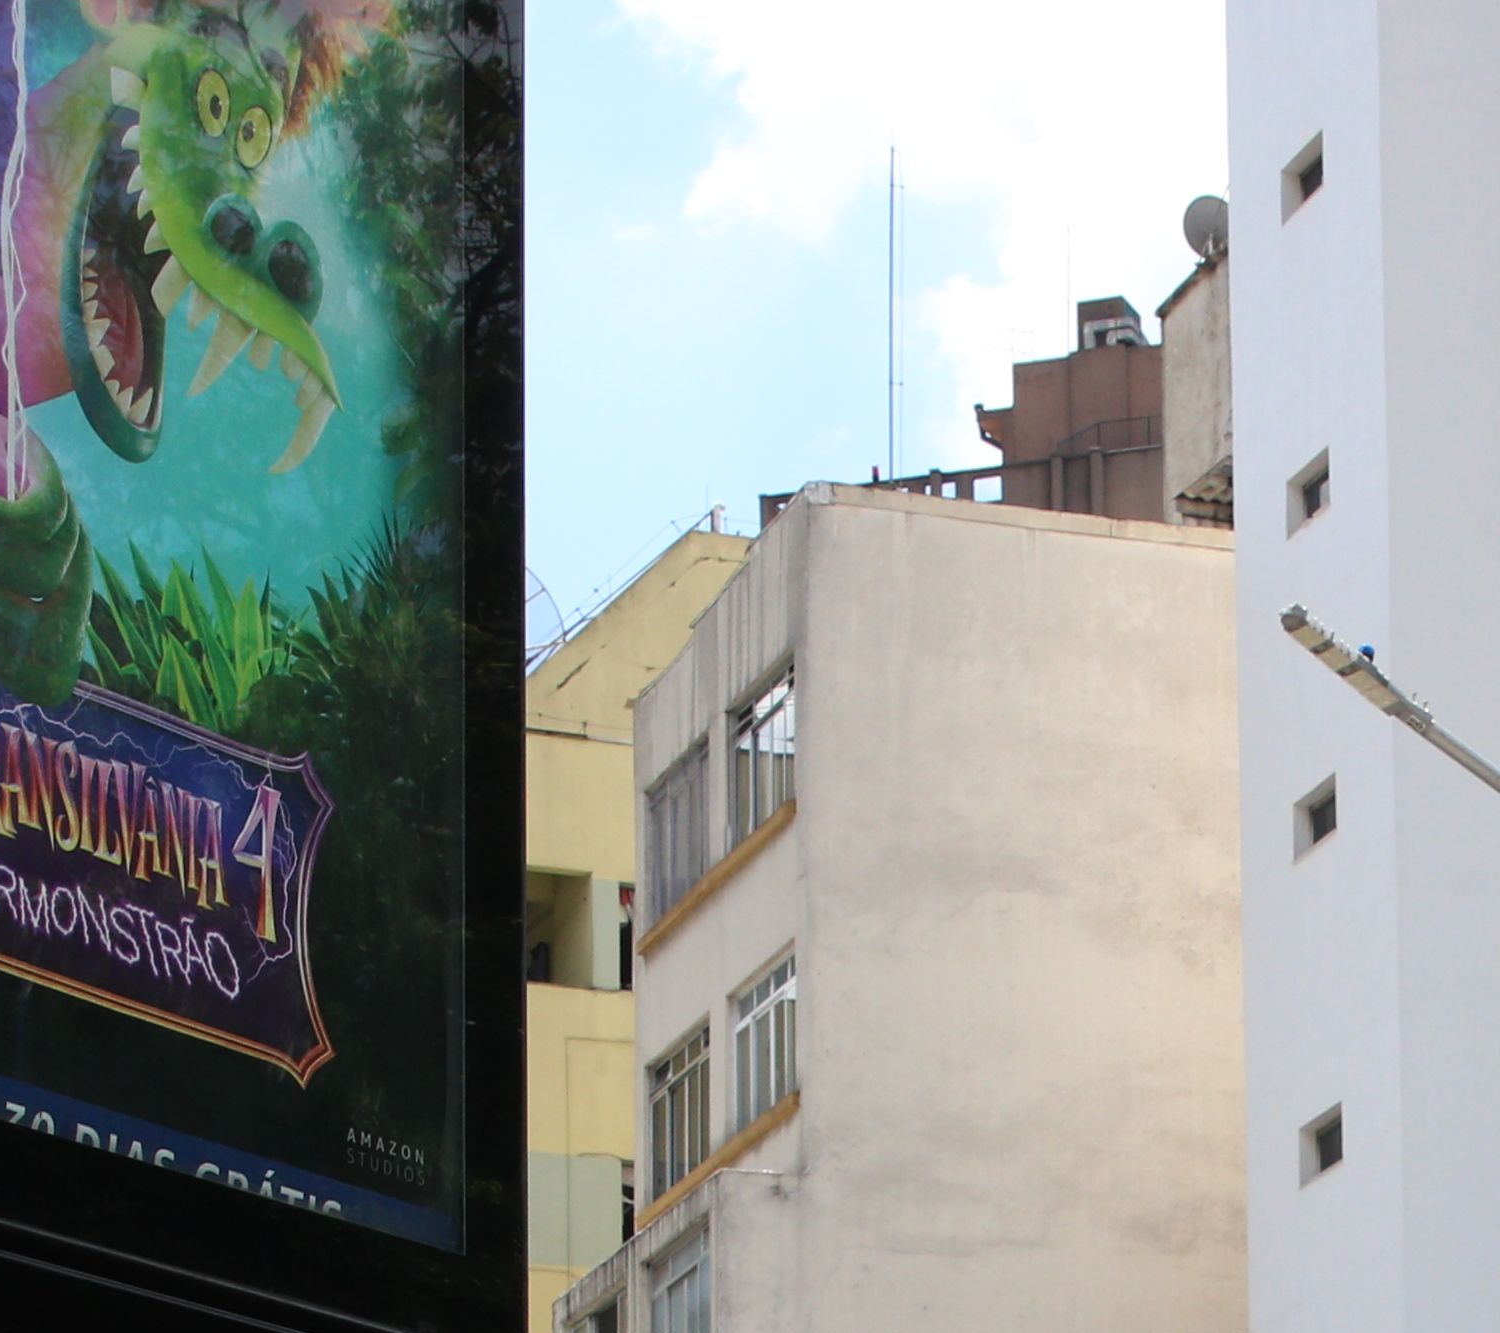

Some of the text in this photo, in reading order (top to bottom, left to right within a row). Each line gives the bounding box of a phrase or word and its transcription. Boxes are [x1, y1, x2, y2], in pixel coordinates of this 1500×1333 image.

[233, 784, 283, 943] 4
[347, 1127, 425, 1165] AMAZON
[347, 1147, 425, 1187] STUDIOS
